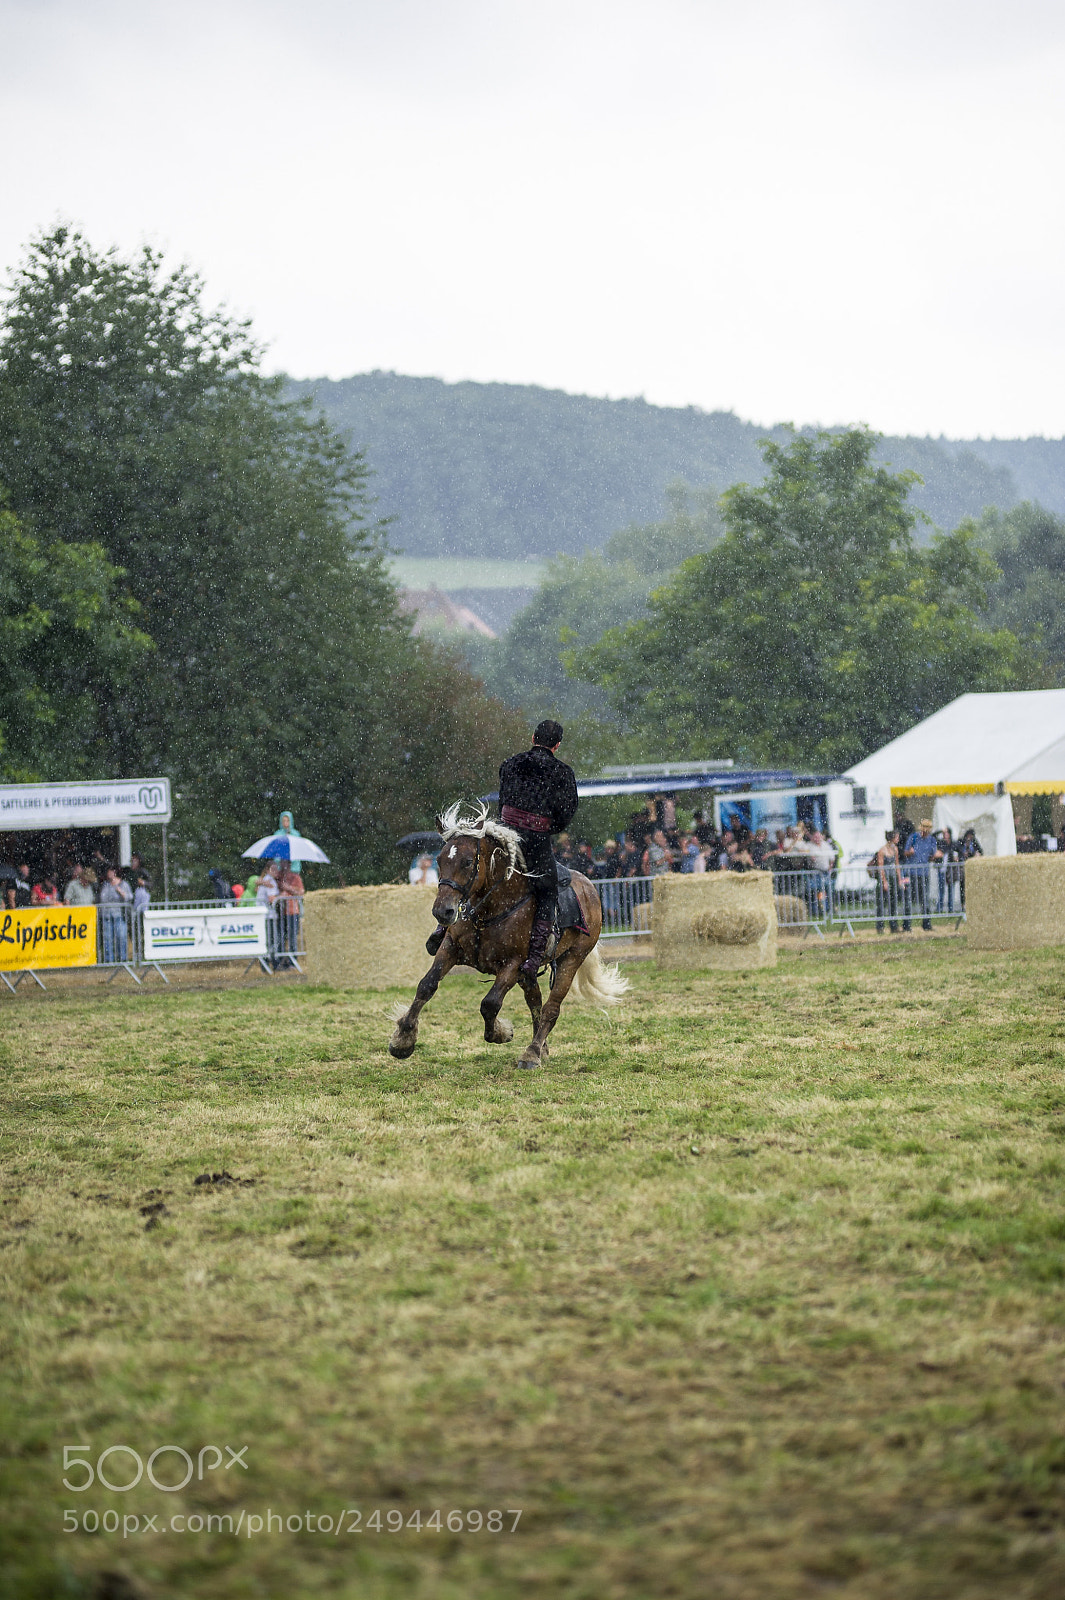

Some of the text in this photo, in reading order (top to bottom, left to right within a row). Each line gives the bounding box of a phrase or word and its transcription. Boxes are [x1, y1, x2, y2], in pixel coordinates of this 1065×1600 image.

[1, 797, 41, 809] SATTLEREI
[0, 914, 88, 951] Lippische
[151, 923, 254, 937] DEUTZ FAHR
